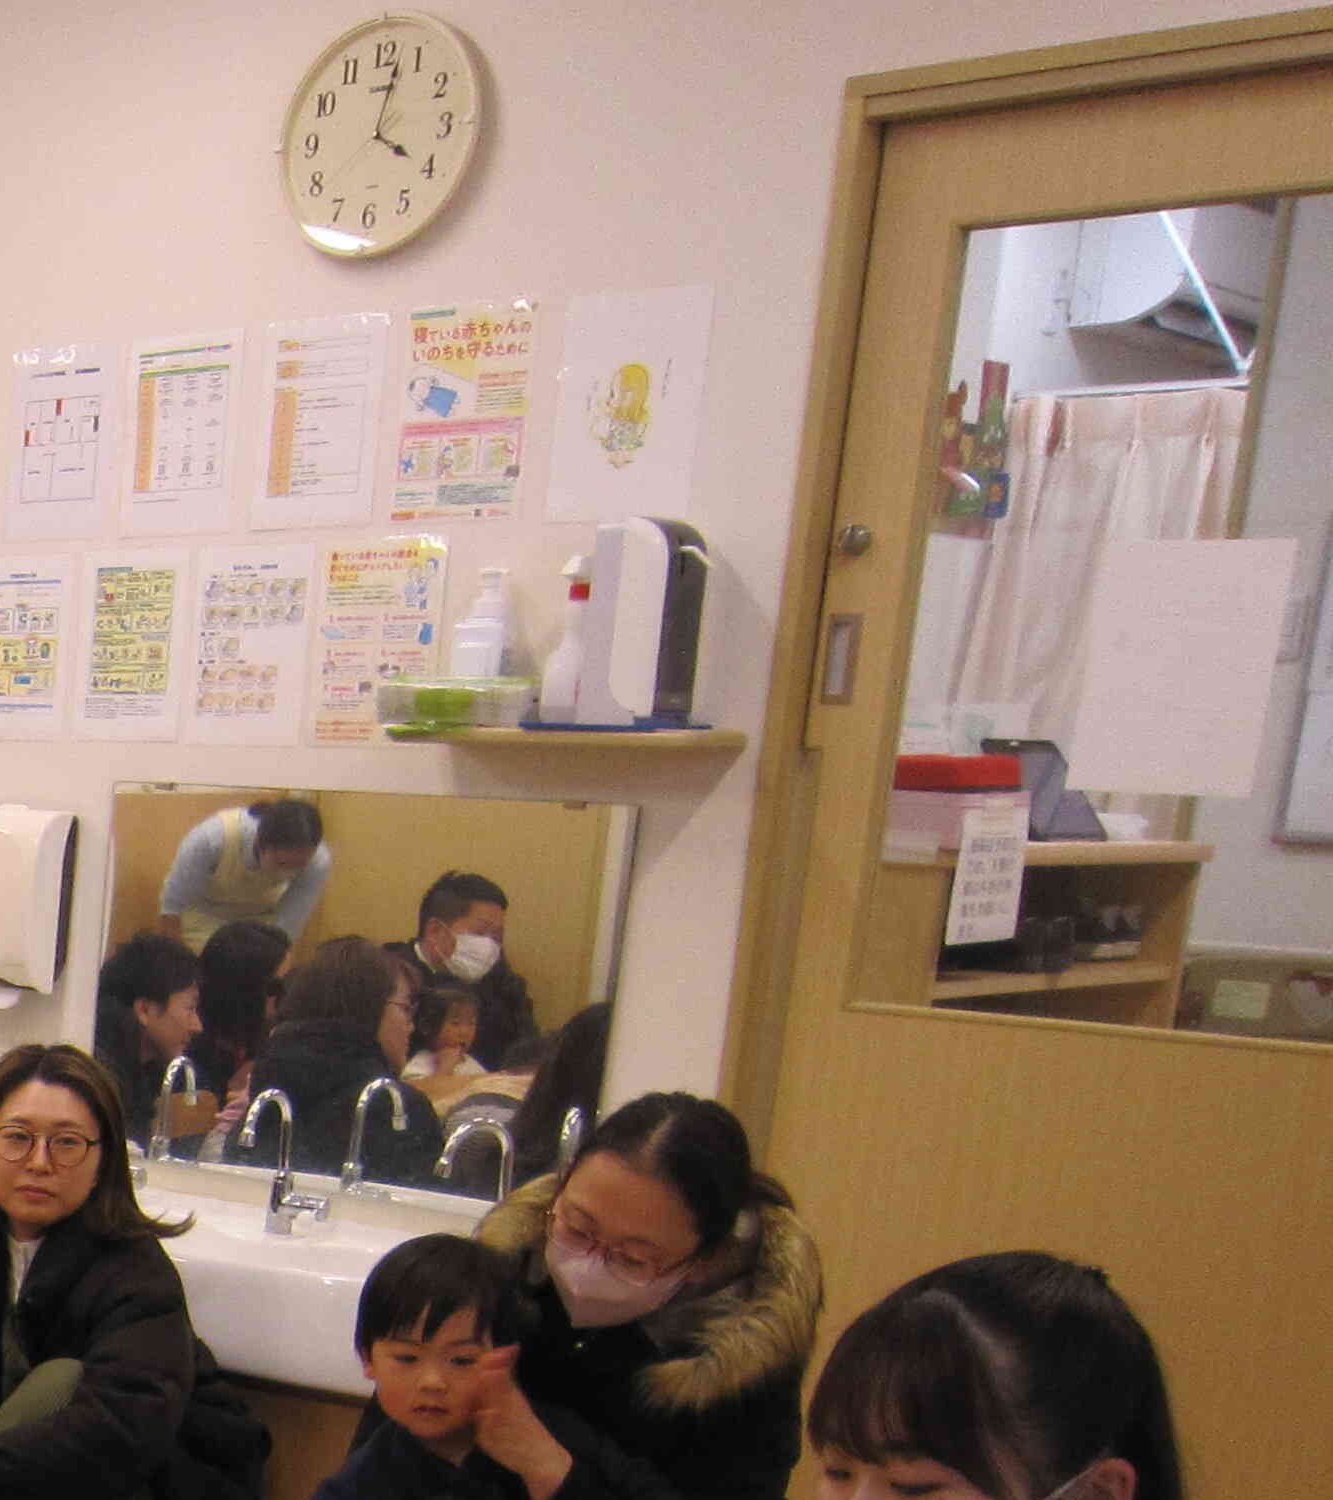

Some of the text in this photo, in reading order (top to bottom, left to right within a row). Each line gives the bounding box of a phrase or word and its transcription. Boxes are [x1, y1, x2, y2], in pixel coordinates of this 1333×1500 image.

[373, 40, 397, 69] 12
[412, 46, 422, 73] 1
[341, 58, 358, 86] 11
[432, 72, 448, 99] 2
[316, 91, 336, 119] 10
[437, 111, 454, 140] 3
[304, 134, 319, 159] 9
[421, 153, 435, 180] 4
[309, 171, 325, 197] 8
[332, 198, 345, 223] 7
[361, 202, 377, 229] 6
[396, 188, 411, 216] 5
[412, 341, 530, 363] いのちを守るために
